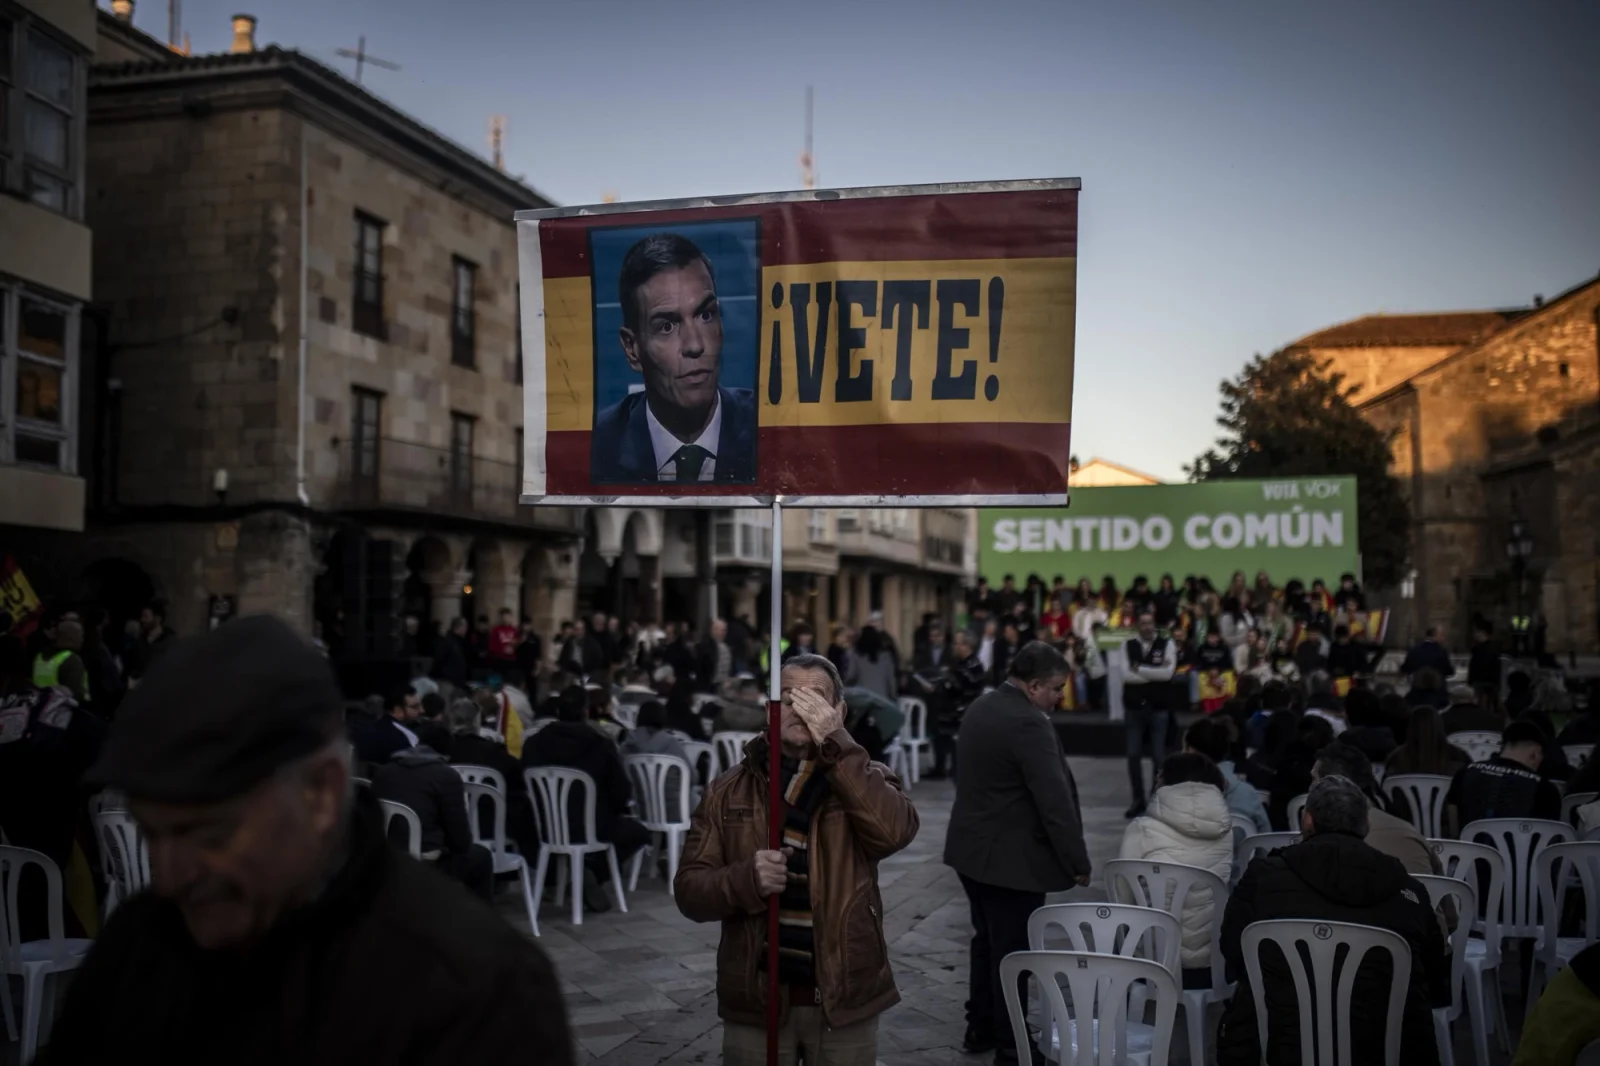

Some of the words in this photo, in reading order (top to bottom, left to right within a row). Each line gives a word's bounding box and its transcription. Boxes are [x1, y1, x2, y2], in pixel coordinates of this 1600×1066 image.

[768, 276, 1004, 405] ¡VETE!
[1304, 480, 1341, 499] VOX
[992, 514, 1173, 553] SENTIDO
[1184, 505, 1344, 549] COMÚN
